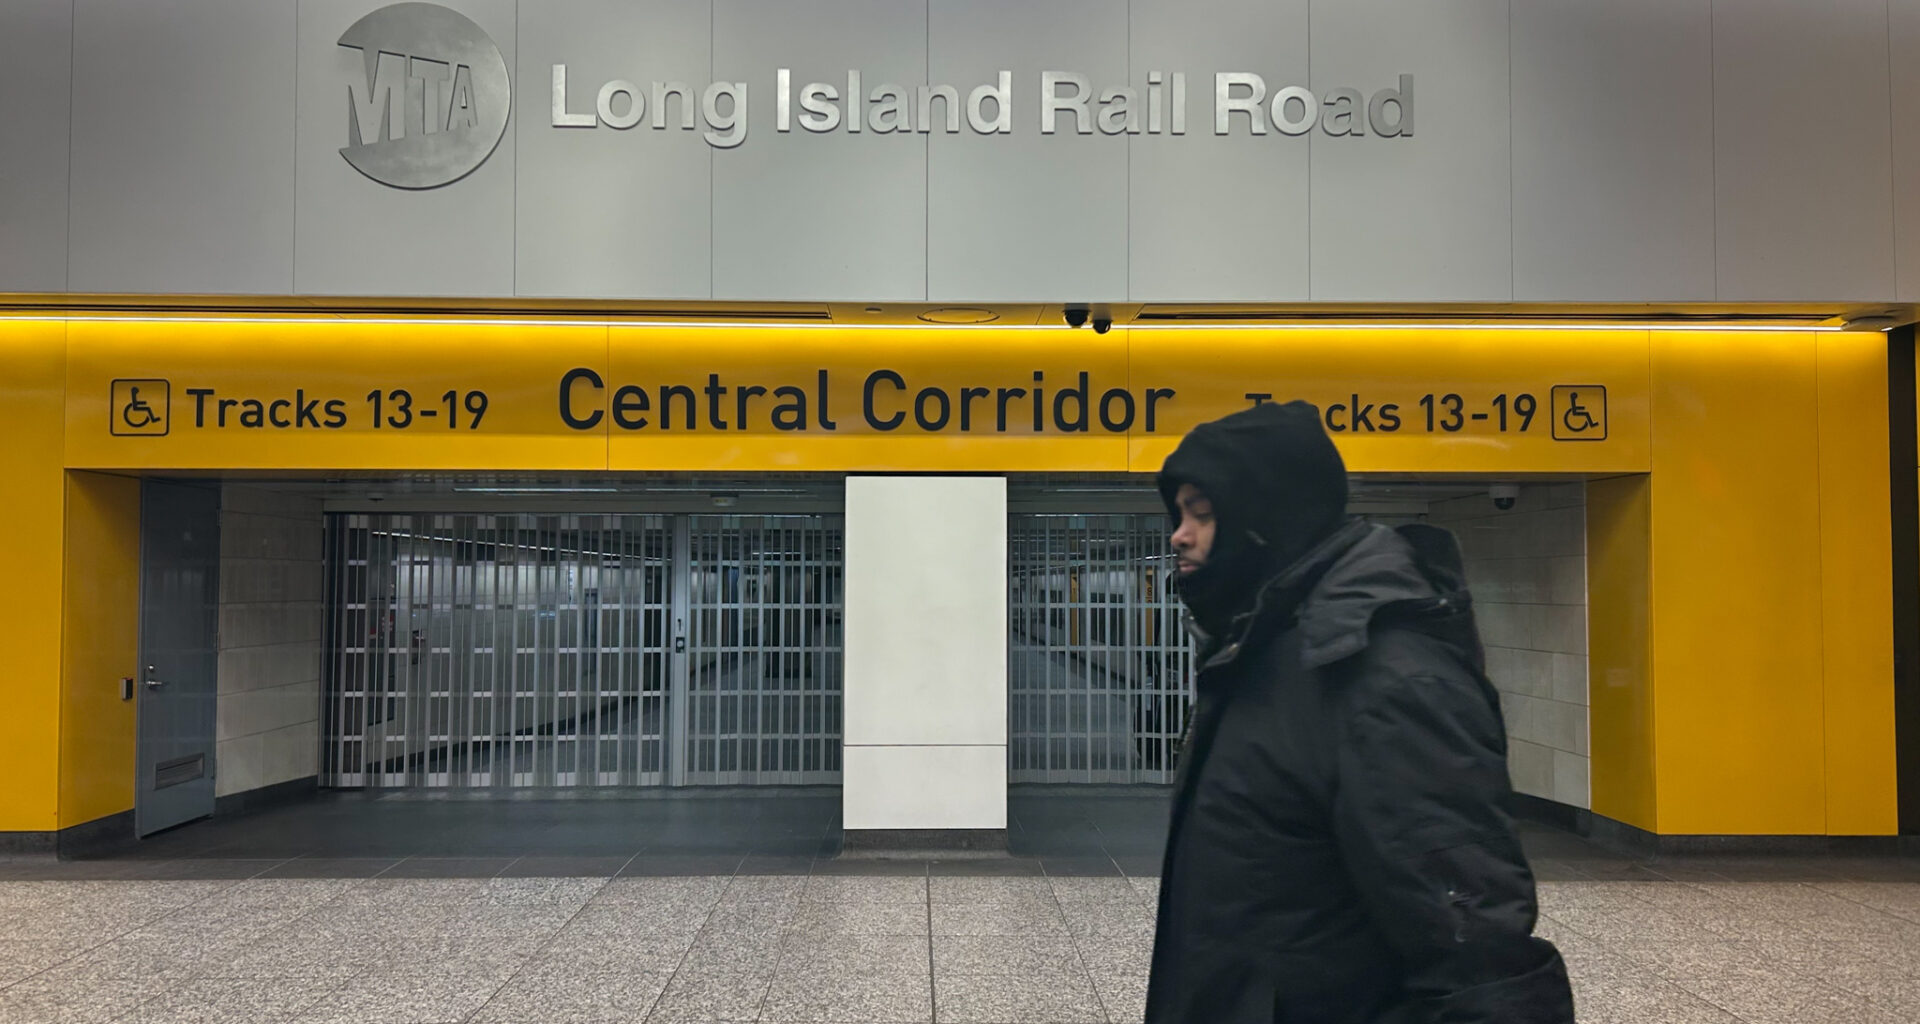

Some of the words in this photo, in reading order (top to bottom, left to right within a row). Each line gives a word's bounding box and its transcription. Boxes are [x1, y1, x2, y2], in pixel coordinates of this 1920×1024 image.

[341, 44, 478, 147] MTA
[551, 63, 749, 149] Long
[776, 68, 1012, 134] Island
[1040, 70, 1187, 136] Rail
[1213, 71, 1415, 138] Road
[186, 388, 347, 429] Tracks
[367, 389, 489, 430] 13-19
[559, 367, 837, 431] Central
[863, 369, 1177, 433] Corridor
[1245, 393, 1401, 432] Tcks
[1419, 393, 1537, 432] 13-19
